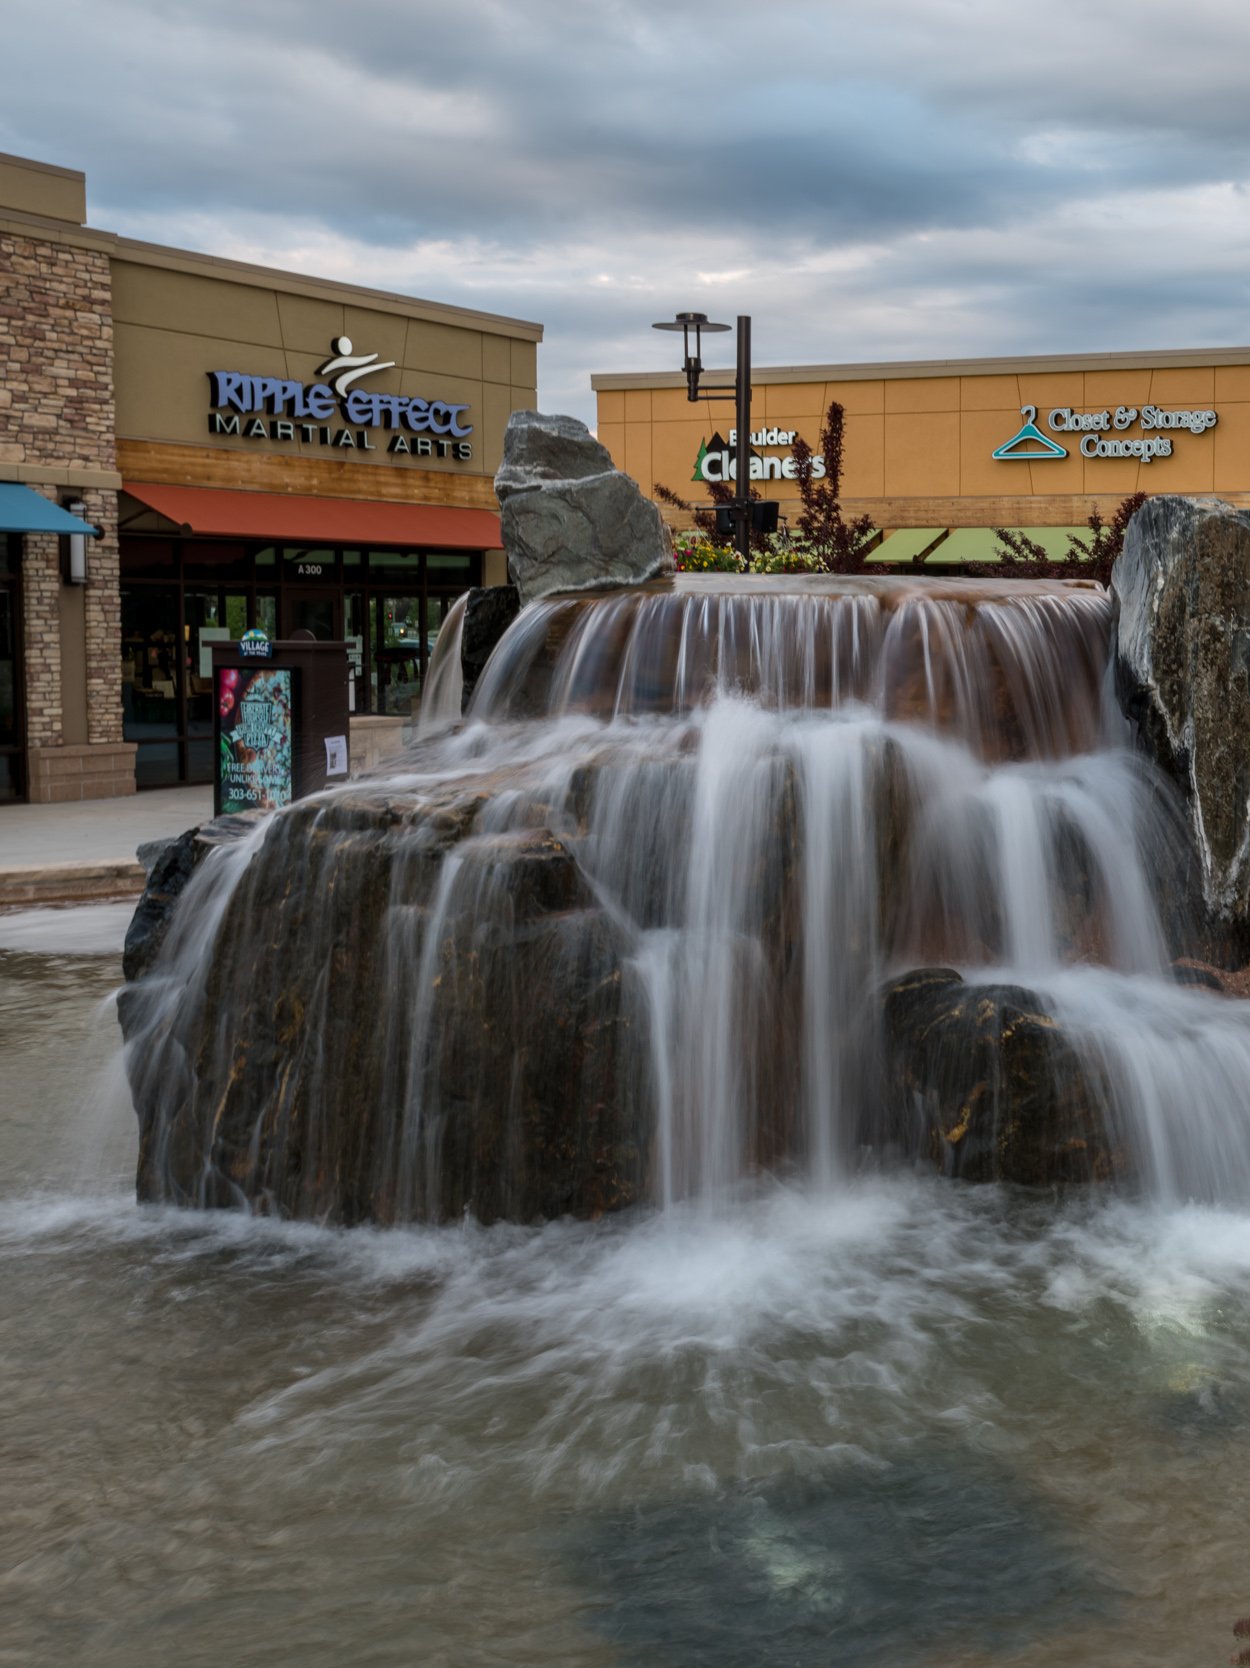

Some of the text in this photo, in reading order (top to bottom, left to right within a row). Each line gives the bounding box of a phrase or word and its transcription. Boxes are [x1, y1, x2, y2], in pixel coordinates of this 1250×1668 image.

[1049, 405, 1217, 434] Closet & Storage
[210, 413, 472, 461] MARTIAL ARTS
[729, 427, 796, 446] Bulder
[1080, 434, 1172, 463] Concepts
[701, 450, 827, 482] Clanes
[240, 640, 270, 652] VILLAGE
